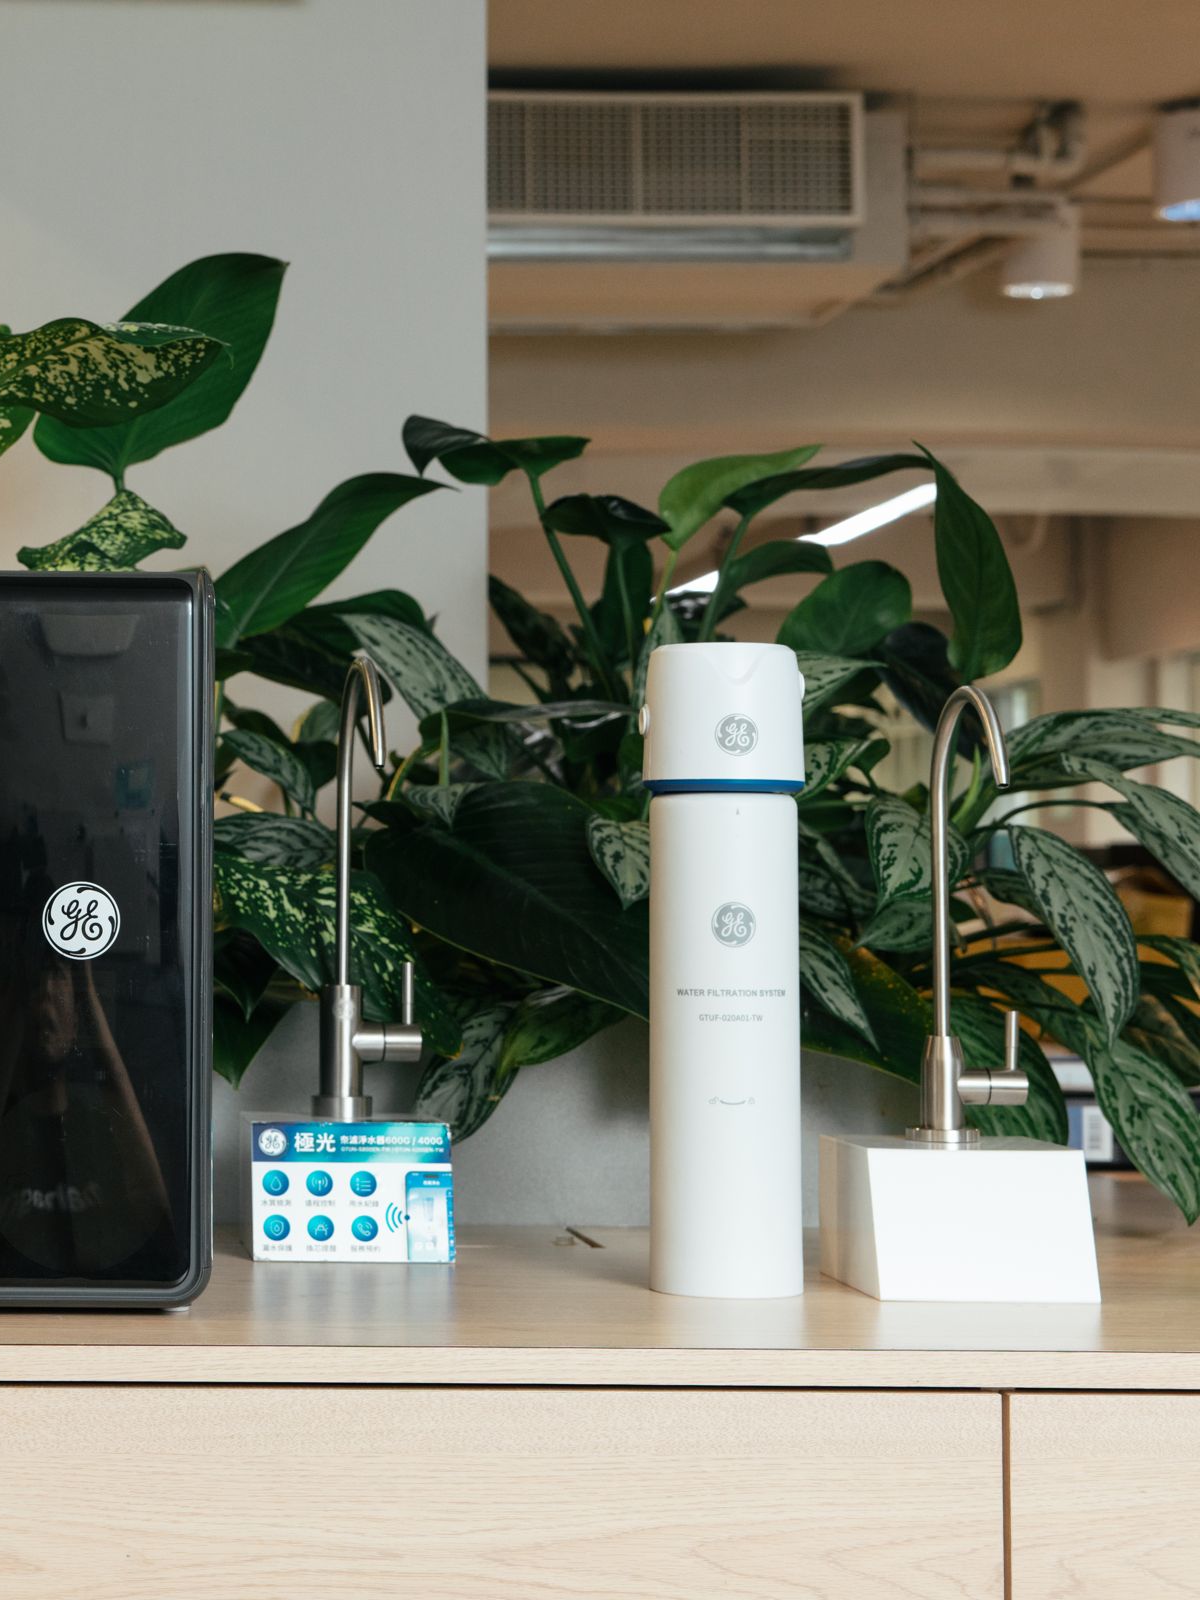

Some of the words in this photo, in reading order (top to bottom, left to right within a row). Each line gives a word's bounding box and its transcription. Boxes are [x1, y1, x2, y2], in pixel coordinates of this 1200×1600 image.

[676, 988, 705, 997] WATER
[707, 988, 758, 998] FILTRATION
[759, 989, 786, 998] SYSTEM
[294, 1132, 336, 1153] 極光
